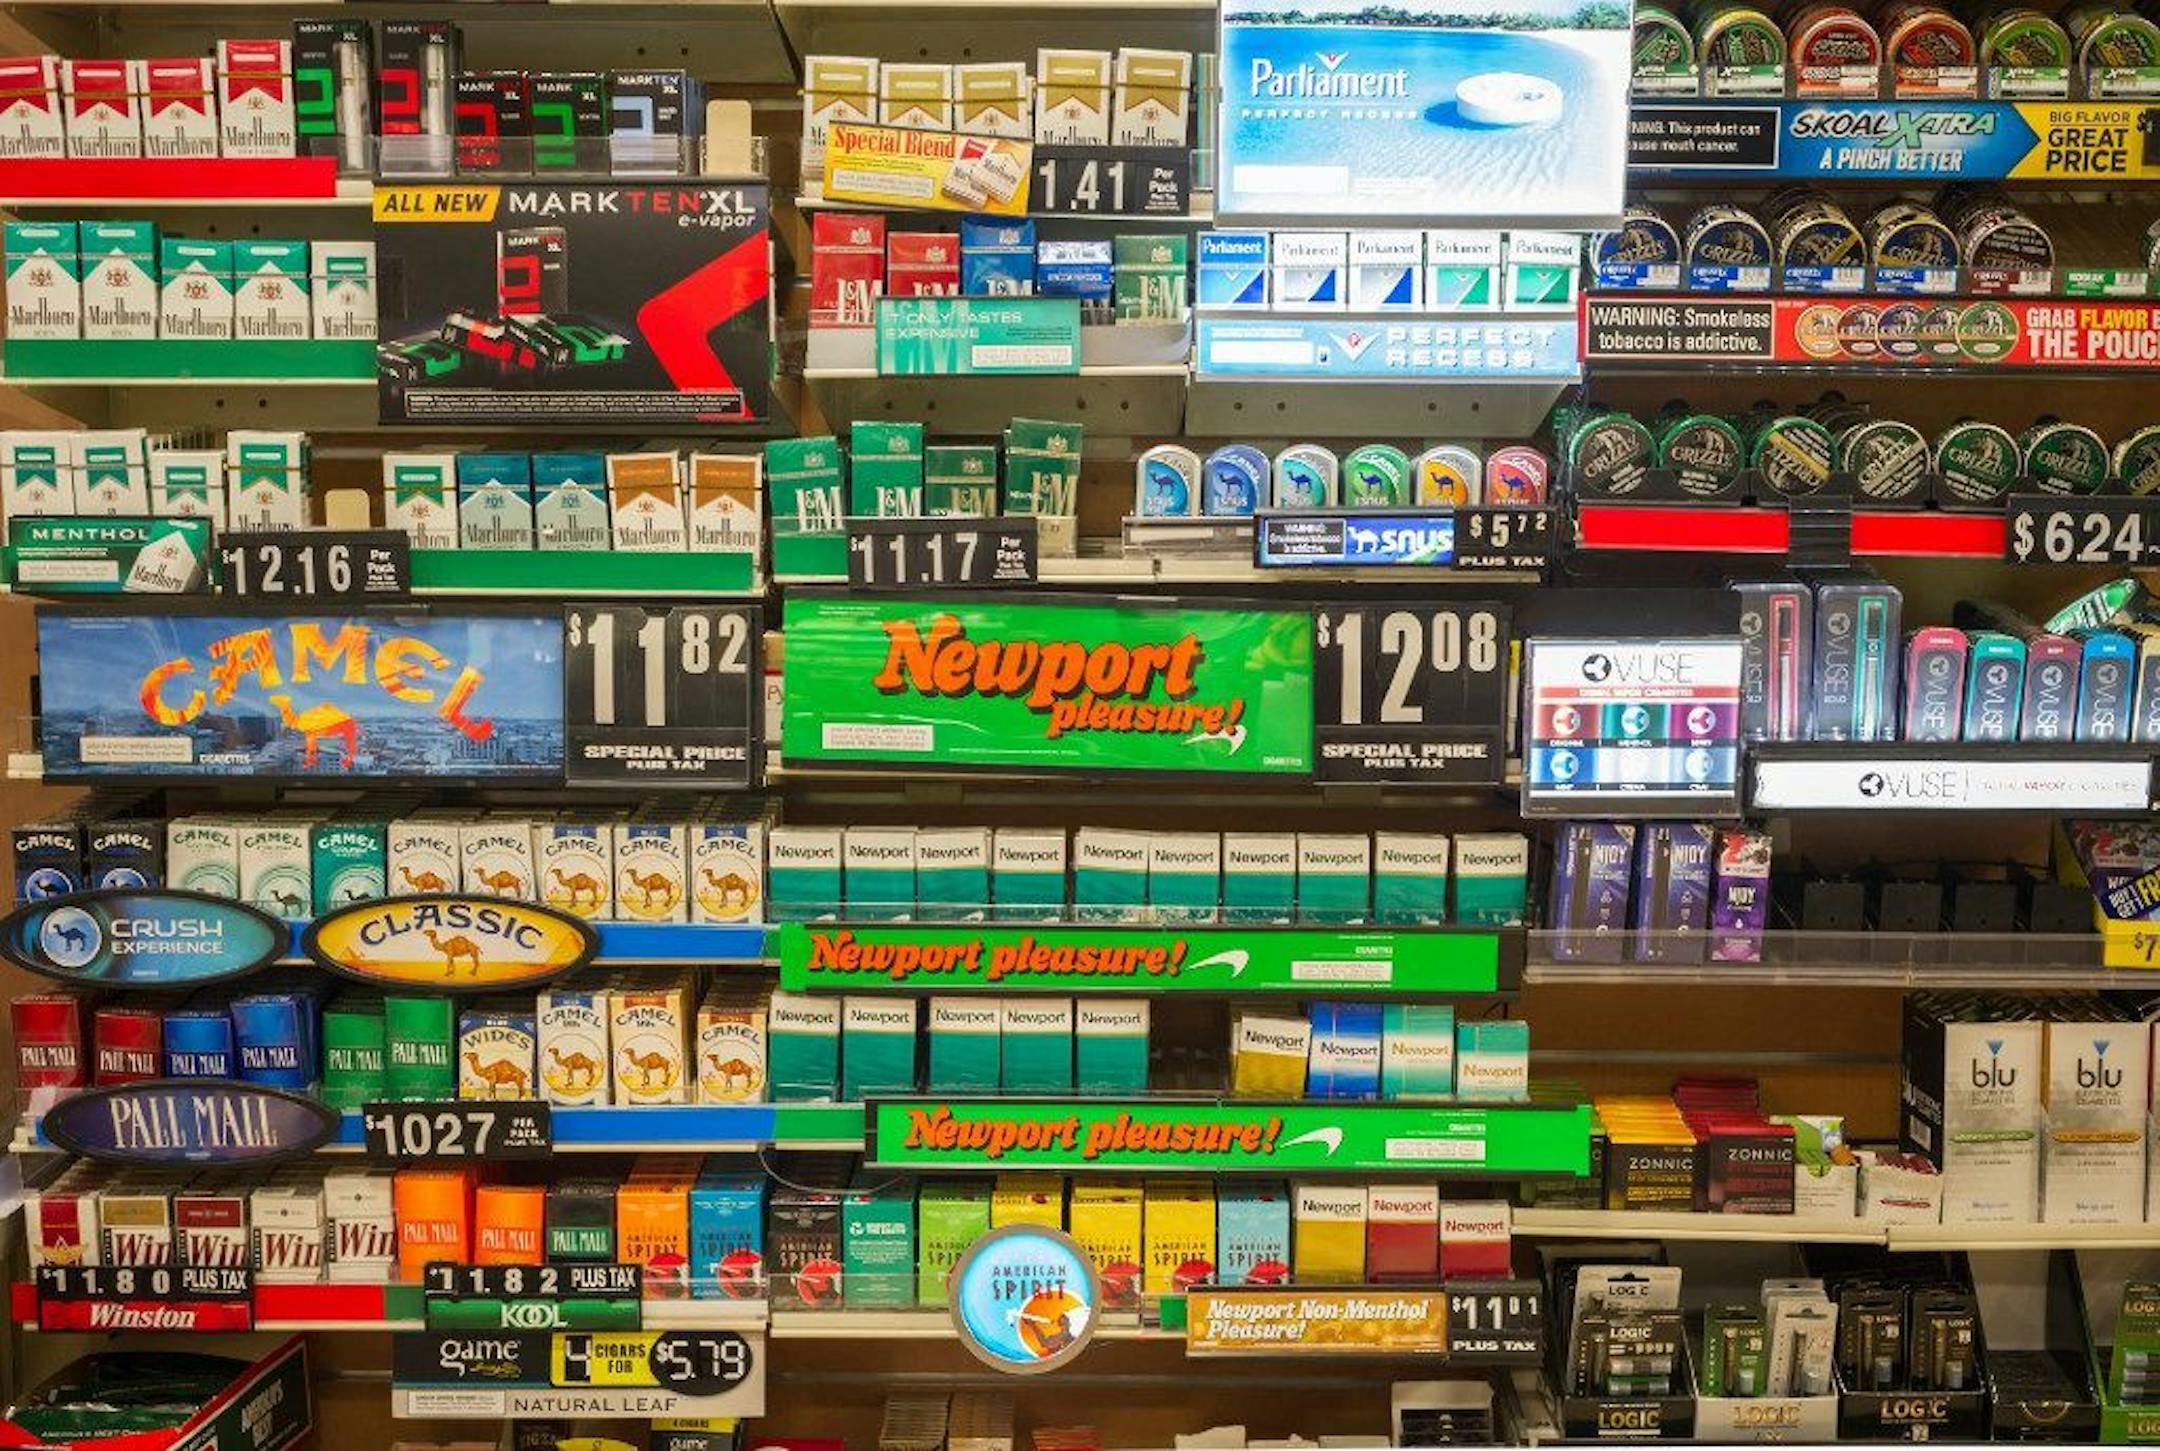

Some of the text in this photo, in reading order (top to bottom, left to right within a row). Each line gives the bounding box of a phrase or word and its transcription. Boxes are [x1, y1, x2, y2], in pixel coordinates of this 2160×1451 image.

[1251, 58, 1408, 98] Parliament
[1793, 112, 1888, 135] SKOAL
[2050, 111, 2130, 122] BIG FLAVOR
[835, 127, 899, 154] Special
[905, 130, 956, 158] Blend
[2048, 128, 2129, 148] GREAT
[1820, 148, 1963, 172] A PINCH BETTER
[2046, 150, 2128, 172] PRICE
[1153, 168, 1174, 181] Per
[384, 193, 487, 213] ALL NEW
[705, 192, 756, 214] XL
[678, 213, 756, 231] e-vapor
[1202, 240, 1262, 255] Parliament
[960, 312, 1022, 324] TASTES
[1592, 307, 1770, 328] WARNING: Smokeless
[2026, 309, 2148, 329] GRAB FLAVOR
[885, 328, 980, 340] EXPENSIVE
[1387, 328, 1554, 347] PERFECT
[1598, 332, 1762, 353] tobacco is addictive.
[2027, 330, 2079, 359] THE
[32, 527, 150, 542] MENTHOL
[466, 516, 528, 545] Marlboro
[1001, 536, 1022, 548] Per
[369, 549, 391, 561] Per
[997, 549, 1026, 563] Pack
[1459, 556, 1546, 567] PLUS TAX
[366, 561, 396, 575] Pack
[874, 613, 1206, 712] Newport
[1613, 653, 1694, 683] VUSE
[140, 622, 494, 742] CAMEL
[1047, 698, 1246, 738] pleasure!
[584, 745, 747, 761] SPECIAL PRICE
[1322, 743, 1489, 758] SPECIAL PRICE
[626, 761, 706, 771] PLUS TAX
[1364, 758, 1445, 769] PLUS TAX
[394, 836, 455, 859] CAMEL
[545, 838, 607, 859] CAMEL
[620, 838, 680, 859] CAMEL
[696, 838, 756, 859] CAMEL
[1000, 847, 1060, 863] Newport
[1382, 849, 1441, 866] Newport
[1304, 850, 1364, 866] Newport
[110, 918, 223, 938] CRUSH
[361, 903, 543, 950] CLASSIC
[110, 942, 224, 955] EXPERIENCE
[808, 930, 1188, 981] Newport pleasure!
[542, 1008, 601, 1029] CAMEL
[615, 1007, 676, 1028] CAMEL
[463, 1028, 531, 1051] WIDES
[702, 1025, 760, 1045] CAMEL
[1245, 1029, 1304, 1049] Newport
[21, 1047, 77, 1068] PALL MALL
[242, 1046, 298, 1070] PALL MALL
[392, 1042, 448, 1066] PALL MALL
[1320, 1041, 1378, 1058] Newport
[1392, 1041, 1449, 1058] Newport
[1463, 1063, 1523, 1080] Newport
[1972, 1058, 2016, 1088] blu
[2077, 1058, 2123, 1088] blu
[110, 1096, 278, 1149] PALL MALL
[512, 1117, 535, 1128] PER
[510, 1129, 538, 1138] PACK
[905, 1105, 1283, 1161] Newport pleasure!
[1629, 1157, 1693, 1170] ZONNIC
[1728, 1148, 1793, 1161] ZONNIC
[1303, 1199, 1361, 1216] Newport
[404, 1222, 458, 1243] PALL MALL
[183, 1270, 218, 1290] PLUS
[222, 1271, 247, 1291] TAX
[571, 1268, 606, 1288] PLUS
[609, 1268, 637, 1287] TAX
[993, 1265, 1066, 1277] AMERICAN
[993, 1281, 1066, 1300] SPIRIT
[90, 1303, 197, 1329] Winston
[501, 1304, 571, 1329] KOOL
[1208, 1298, 1431, 1323] Newport Non-Menthol
[1207, 1320, 1306, 1342] Pleasure!
[1610, 1327, 1652, 1339] LOGIC
[1453, 1340, 1536, 1352] PLUS TAX
[440, 1339, 521, 1376] game
[565, 1340, 646, 1377] 4 CIGARS
[608, 1359, 634, 1373] FOR
[514, 1399, 617, 1412] NATURAL
[625, 1398, 678, 1412] LEAF
[1599, 1410, 1660, 1429] LOGIC
